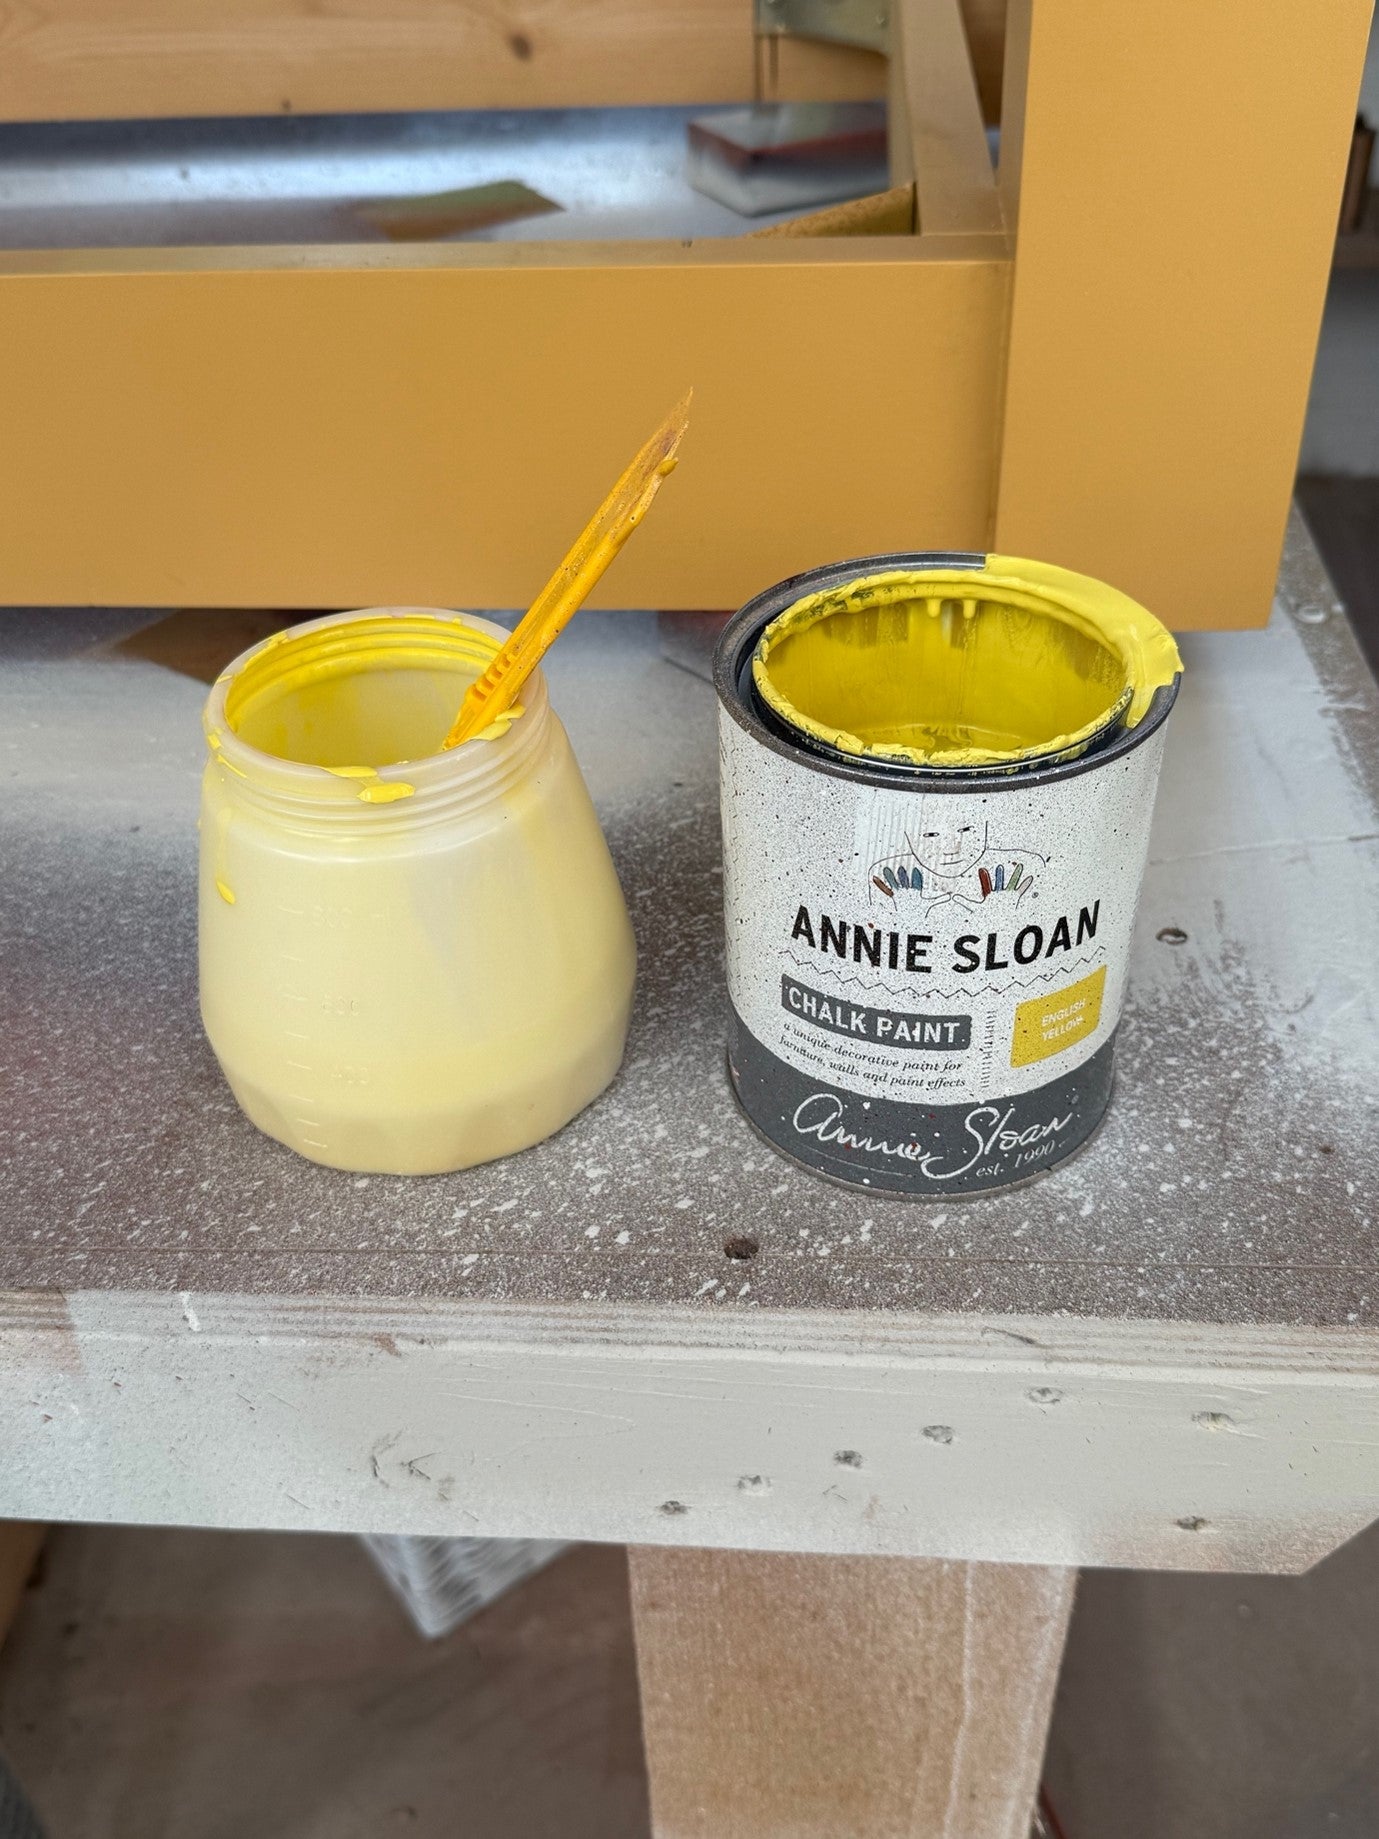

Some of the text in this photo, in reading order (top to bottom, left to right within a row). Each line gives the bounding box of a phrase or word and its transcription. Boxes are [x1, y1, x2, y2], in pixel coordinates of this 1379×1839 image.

[791, 899, 1100, 973] ANNIE SLOAN
[788, 986, 960, 1043] CHALK PAINT
[1041, 998, 1086, 1027] ENGLISH
[1042, 1015, 1084, 1041] YELLOW
[793, 1028, 831, 1051] unique
[834, 1044, 900, 1067] decorative
[902, 1058, 939, 1072] paint
[940, 1059, 963, 1073] for
[829, 1060, 860, 1077] walls
[863, 1072, 889, 1084] and
[890, 1076, 924, 1089] paint
[927, 1076, 966, 1090] effects
[921, 1106, 1072, 1179] Sloan
[975, 1163, 1004, 1178] est.
